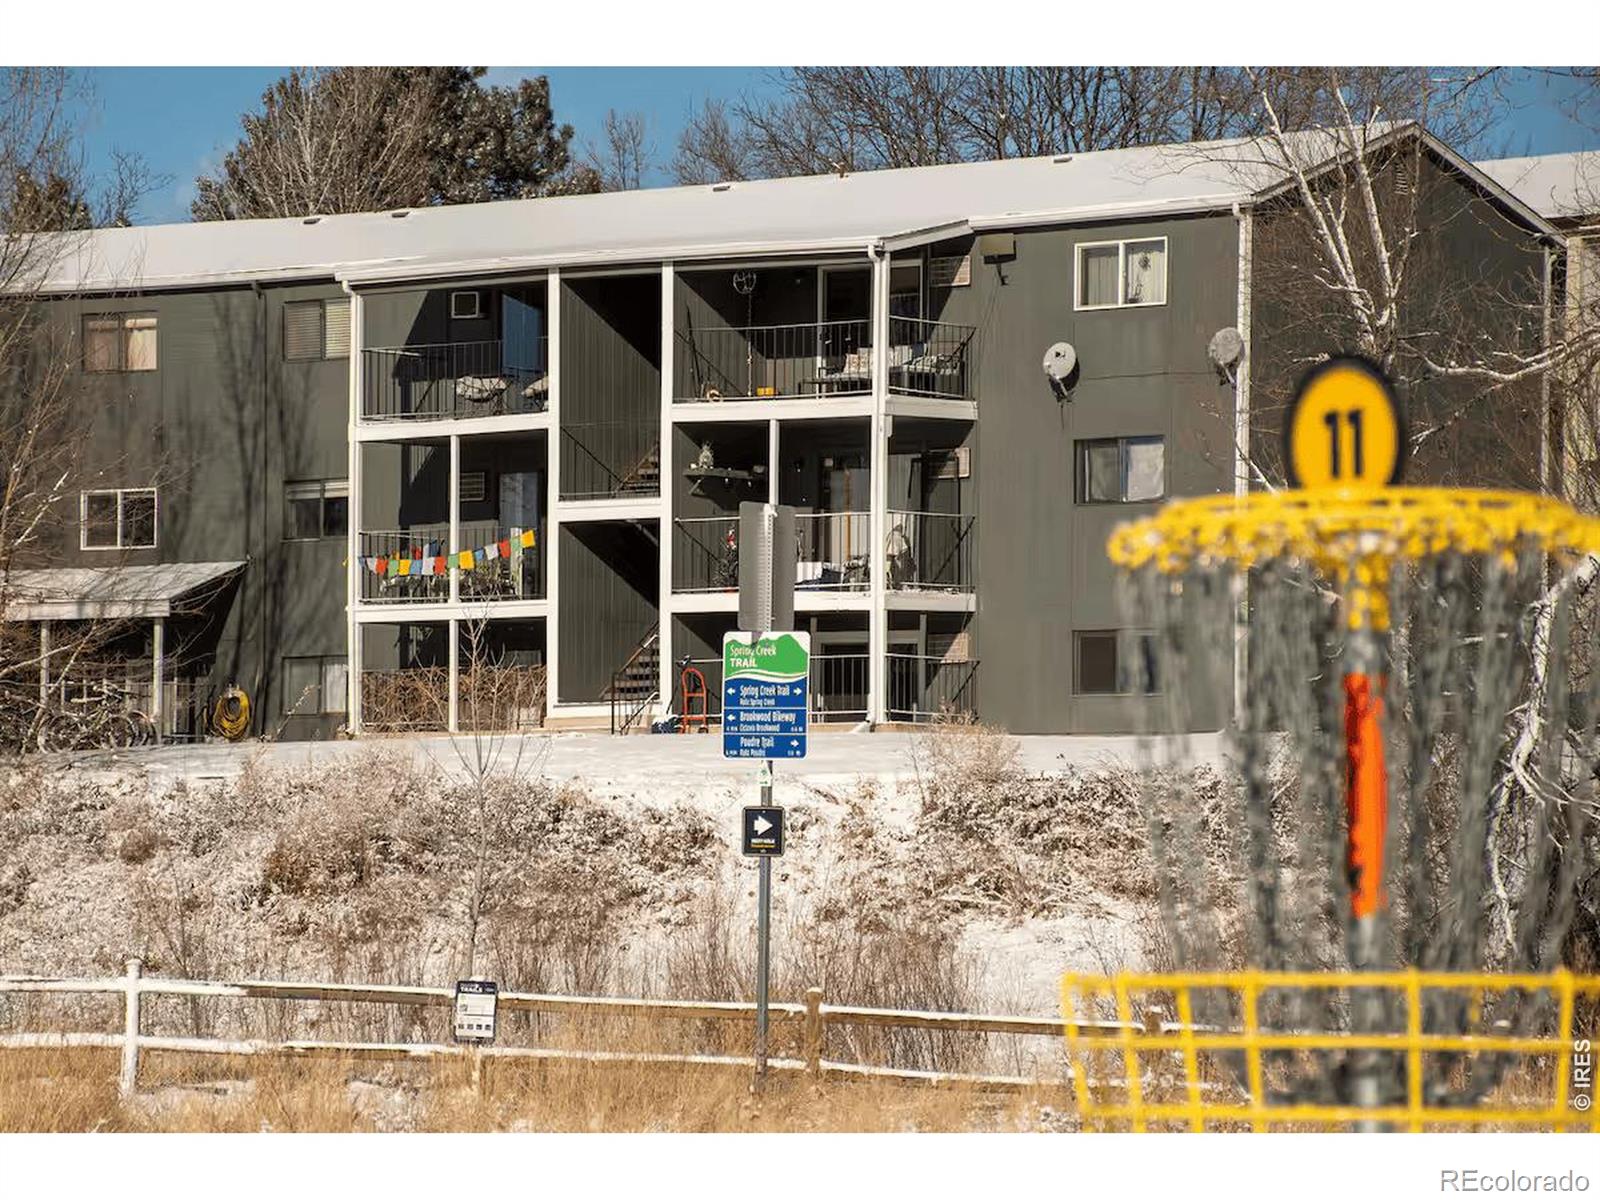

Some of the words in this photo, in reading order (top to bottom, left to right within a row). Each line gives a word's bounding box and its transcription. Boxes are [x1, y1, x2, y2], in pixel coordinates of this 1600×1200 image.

[1324, 410, 1363, 479] 11
[730, 644, 755, 658] Spring
[756, 644, 777, 656] Creek
[730, 658, 758, 668] TRAIL
[740, 685, 759, 699] Spring
[760, 685, 776, 696] Creek
[776, 685, 790, 696] Trail
[740, 711, 771, 722] Brookwood
[772, 711, 796, 724] Bikeway
[740, 736, 760, 747] Poudre
[761, 736, 775, 748] Trail
